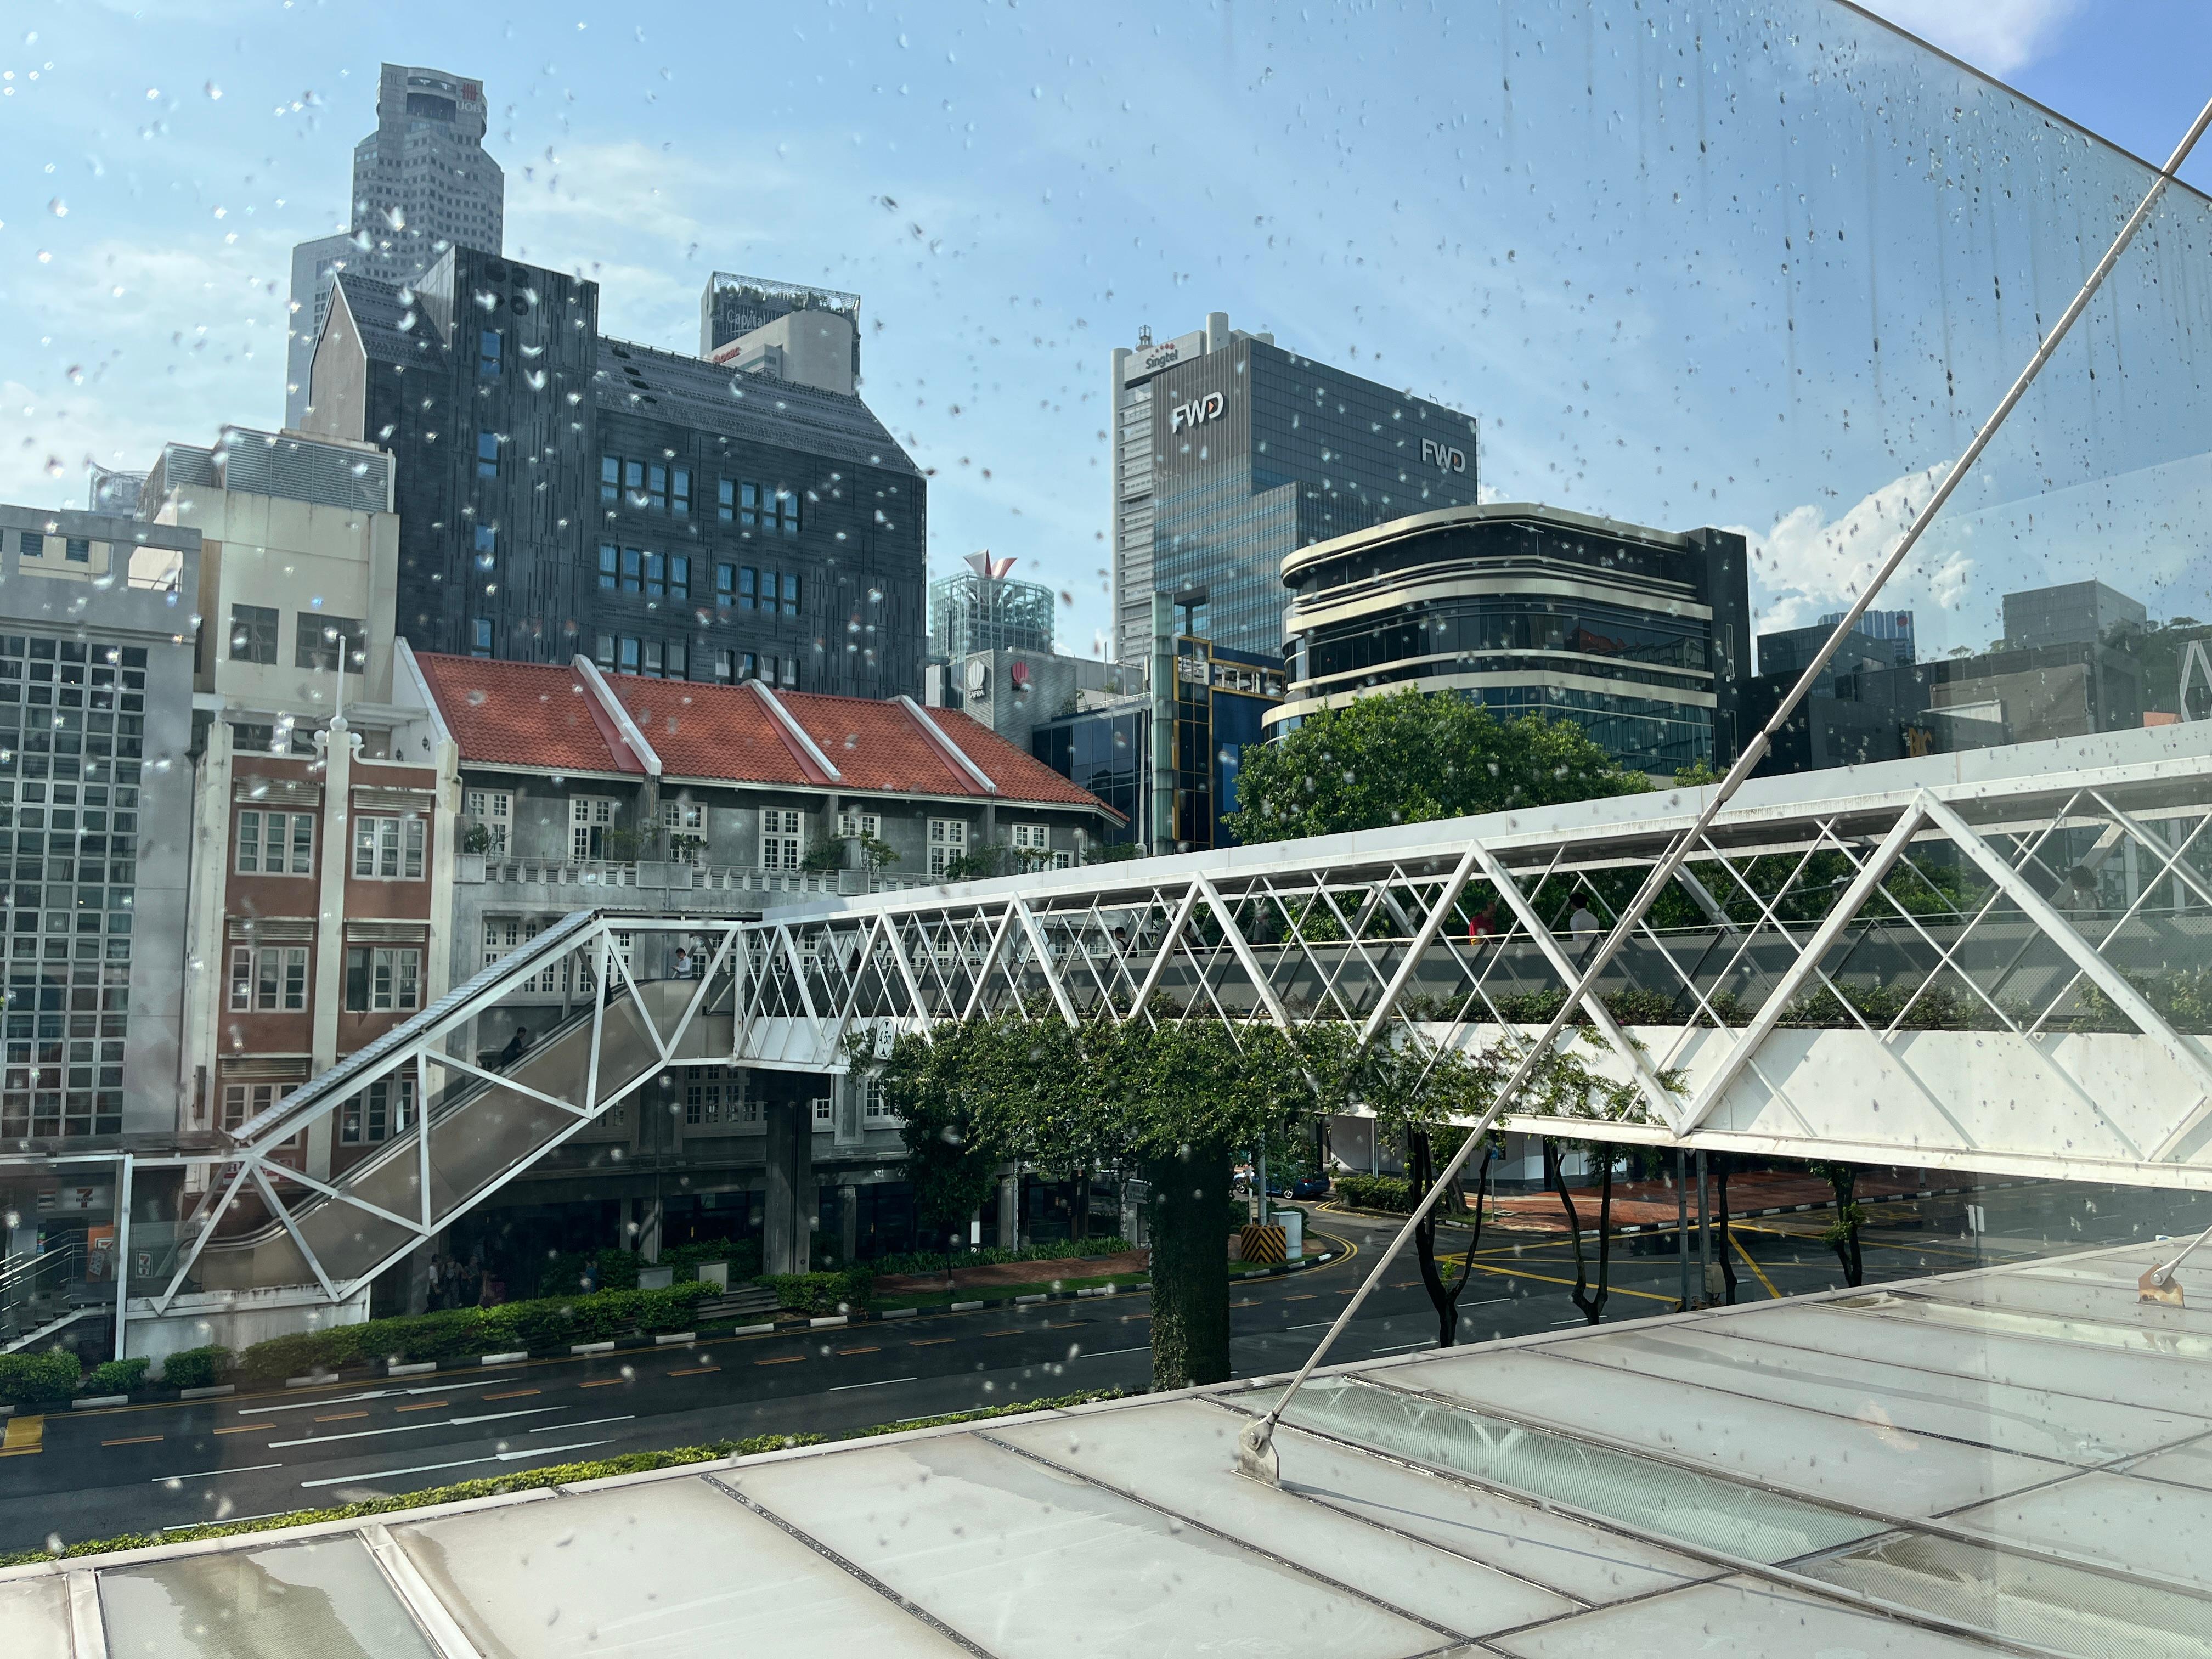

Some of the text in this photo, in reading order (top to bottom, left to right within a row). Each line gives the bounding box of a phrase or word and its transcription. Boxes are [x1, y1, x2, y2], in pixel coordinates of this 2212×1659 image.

[456, 100, 482, 113] UOB
[1146, 349, 1178, 369] Singtel
[1172, 391, 1224, 433] FWD
[1422, 438, 1466, 472] FWD
[968, 689, 984, 698] SAFRA
[879, 1030, 891, 1045] 4.5m
